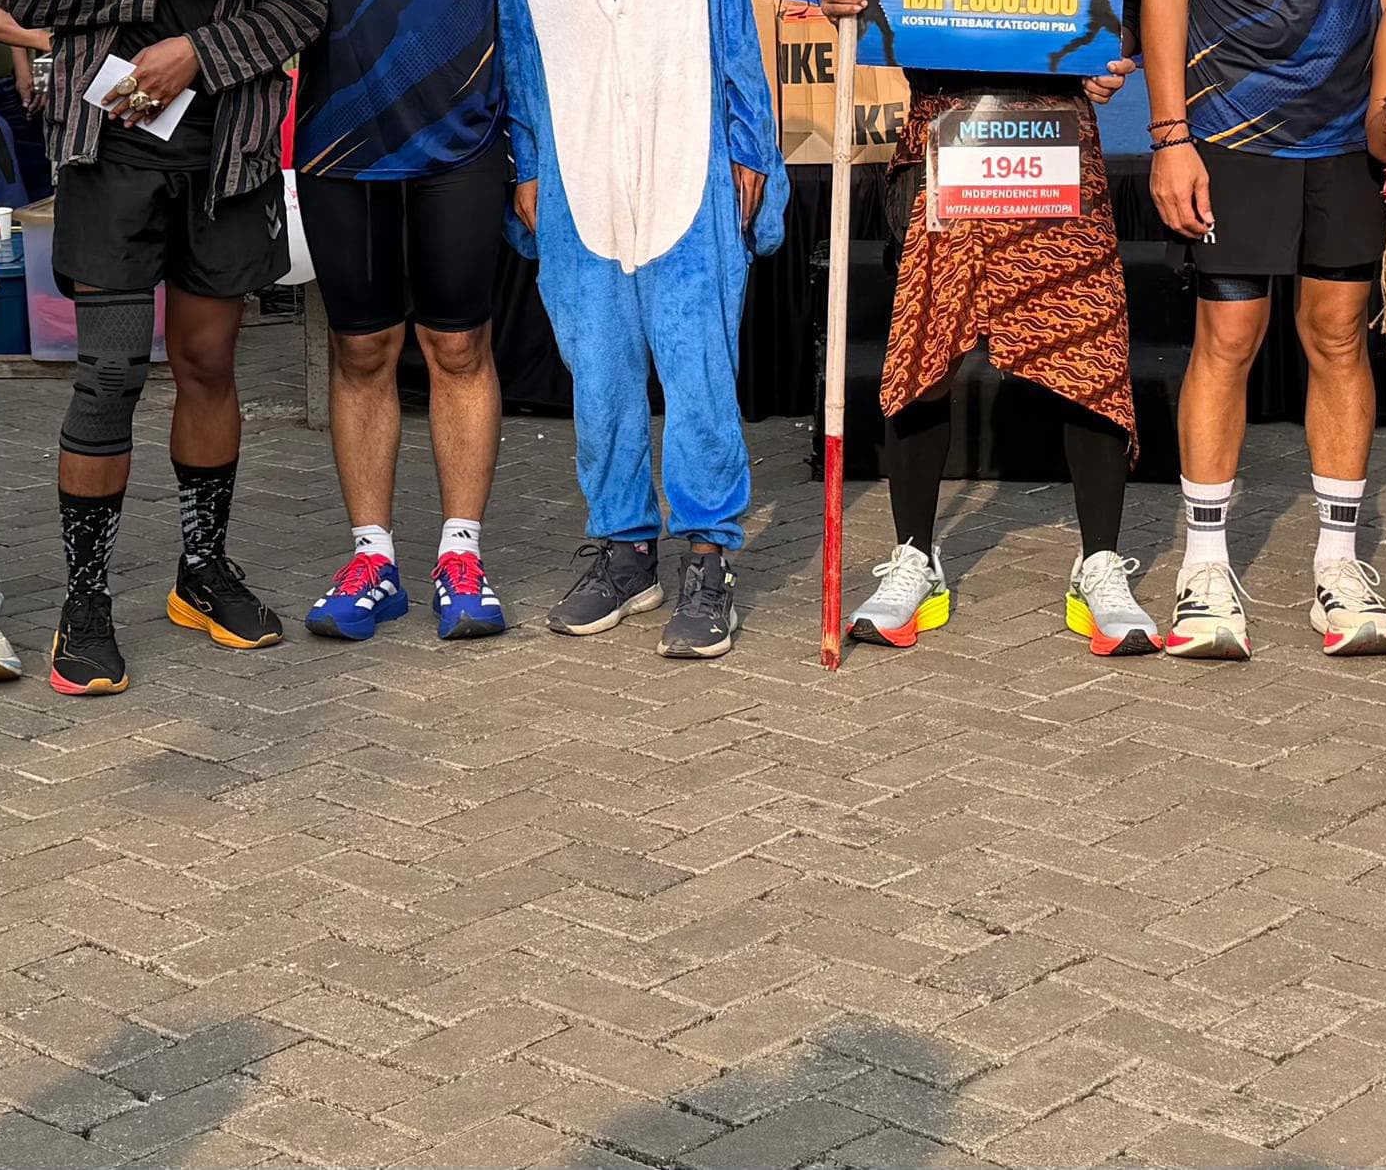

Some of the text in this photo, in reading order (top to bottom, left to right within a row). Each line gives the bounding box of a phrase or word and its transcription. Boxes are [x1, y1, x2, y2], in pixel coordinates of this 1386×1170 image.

[901, 16, 1077, 32] KOSTUM TERBAIK KATEGORI PRIA
[959, 121, 1060, 139] MERDEKA!
[981, 156, 1043, 179] 1945
[961, 189, 1060, 199] INDEPENDENCE RUN
[946, 204, 1073, 214] WITH KANG SAAN MUSTOPA
